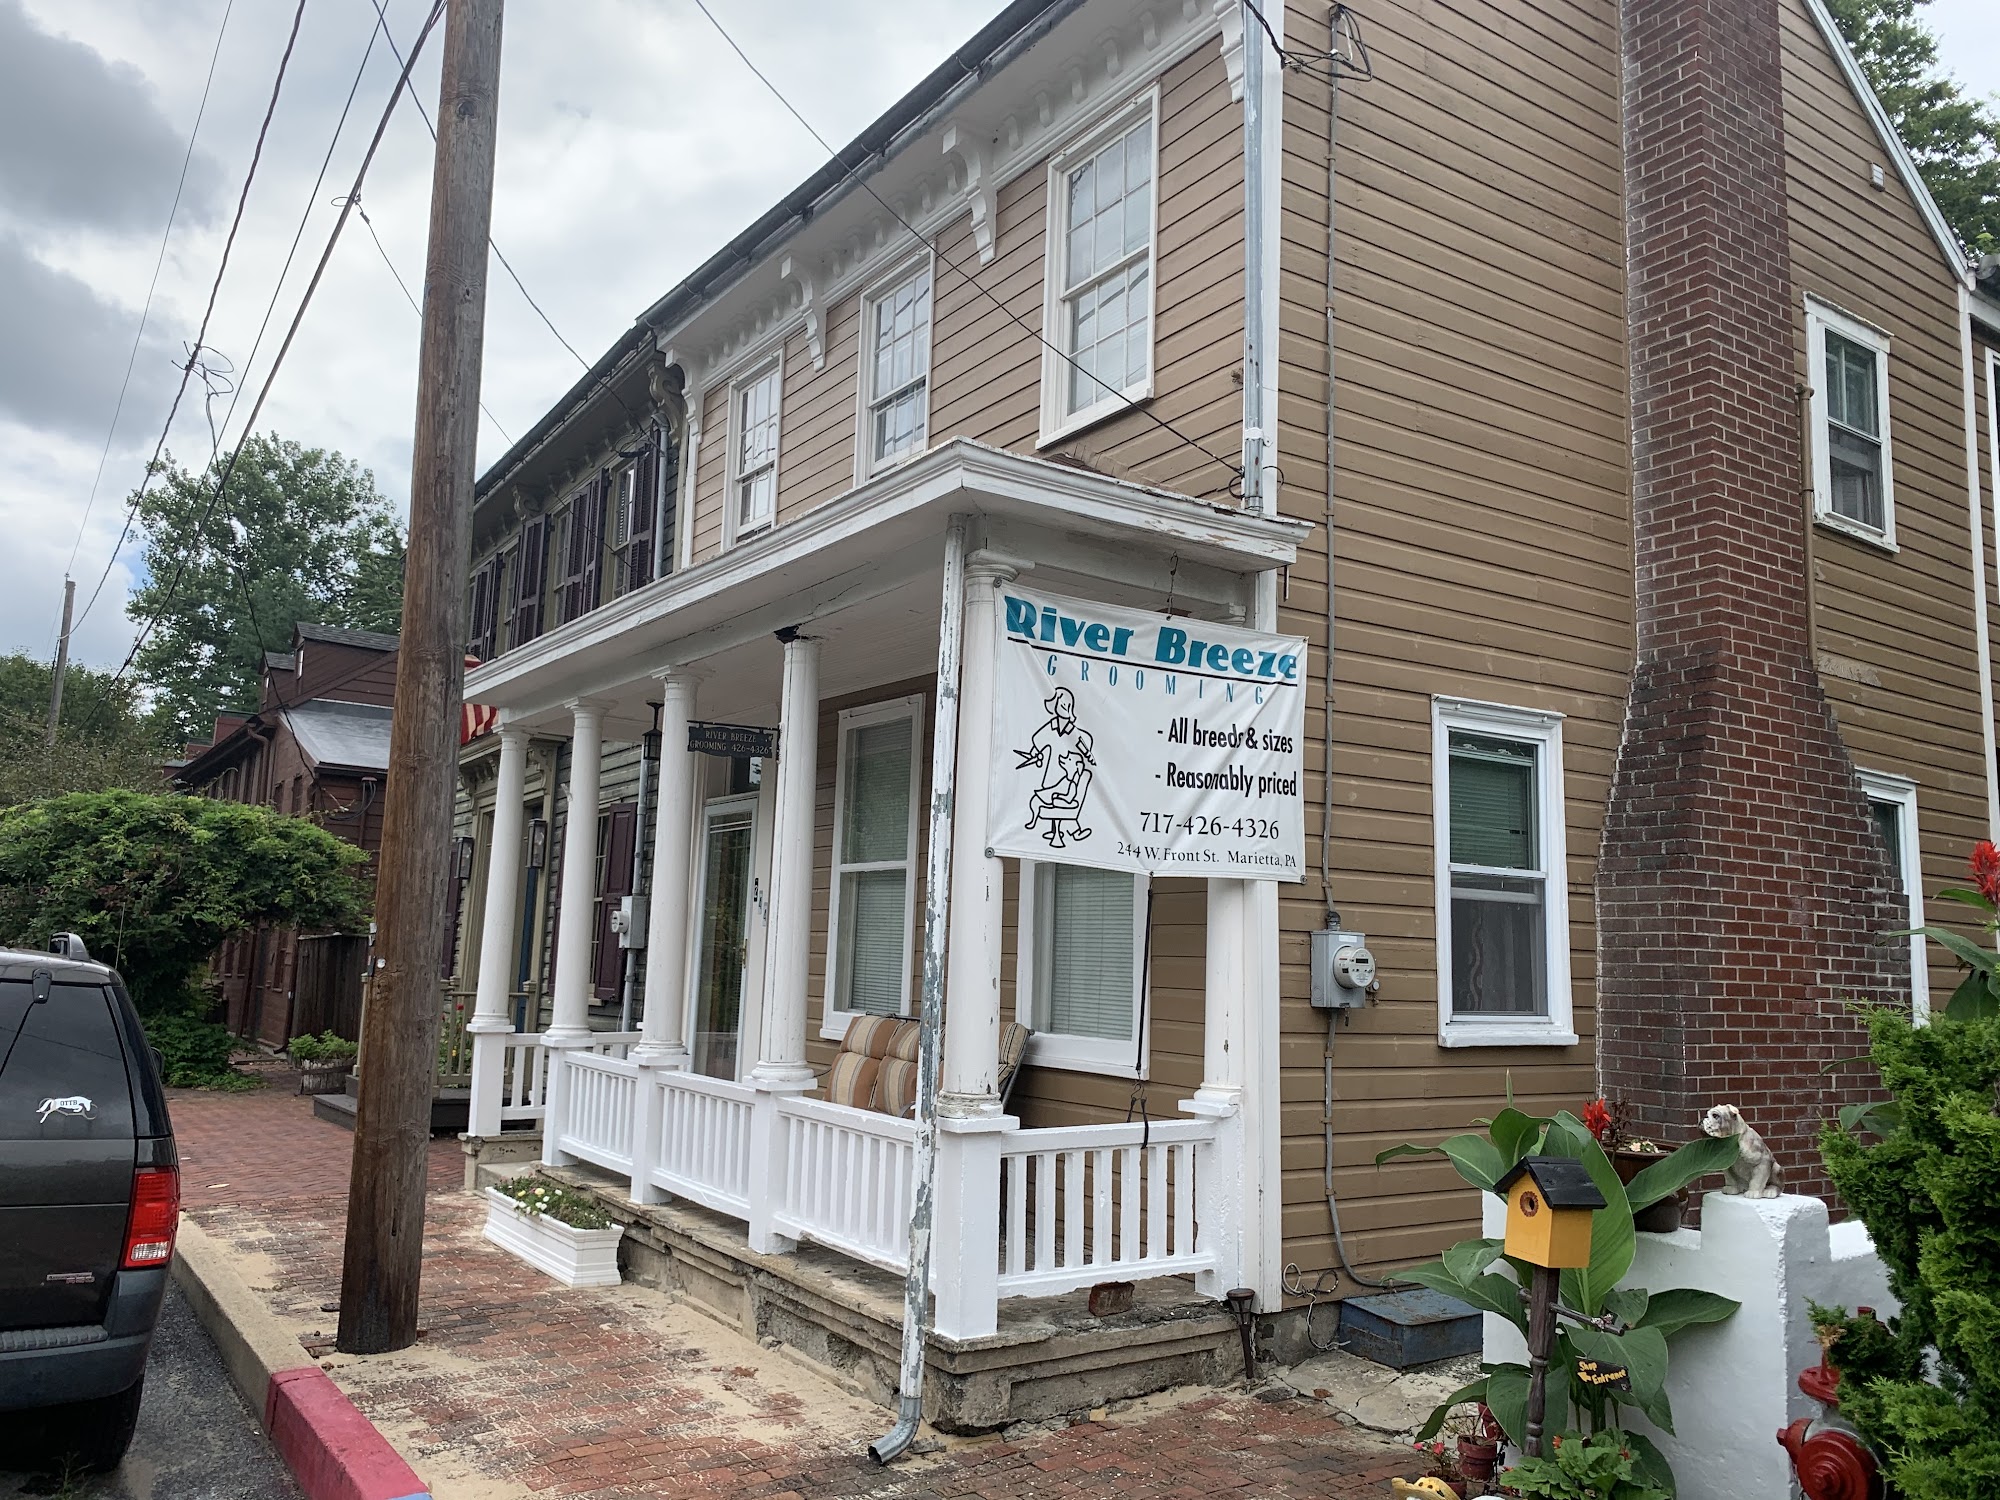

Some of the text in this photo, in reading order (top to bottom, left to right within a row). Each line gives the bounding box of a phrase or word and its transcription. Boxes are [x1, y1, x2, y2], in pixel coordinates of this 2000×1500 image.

[1005, 595, 1297, 679] River Breeze
[1047, 654, 1264, 704] GROOMING
[689, 740, 769, 754] GROOMING 426-4326
[705, 730, 757, 743] RIVER BREEZE
[1168, 717, 1188, 744] All
[1193, 719, 1244, 748] breeds
[1245, 727, 1258, 749] &
[1262, 728, 1293, 753] sizes
[1167, 762, 1253, 798] Reasonably
[1258, 771, 1297, 799] priced
[1140, 811, 1279, 840] 717-426-4326
[1117, 841, 1141, 858] 244
[1163, 848, 1201, 862] Front
[1203, 849, 1219, 863] St.
[1228, 850, 1283, 868] Marietta,
[1285, 854, 1297, 868] PA
[1578, 1361, 1598, 1372] Shop
[1591, 1369, 1626, 1385] Entrance
